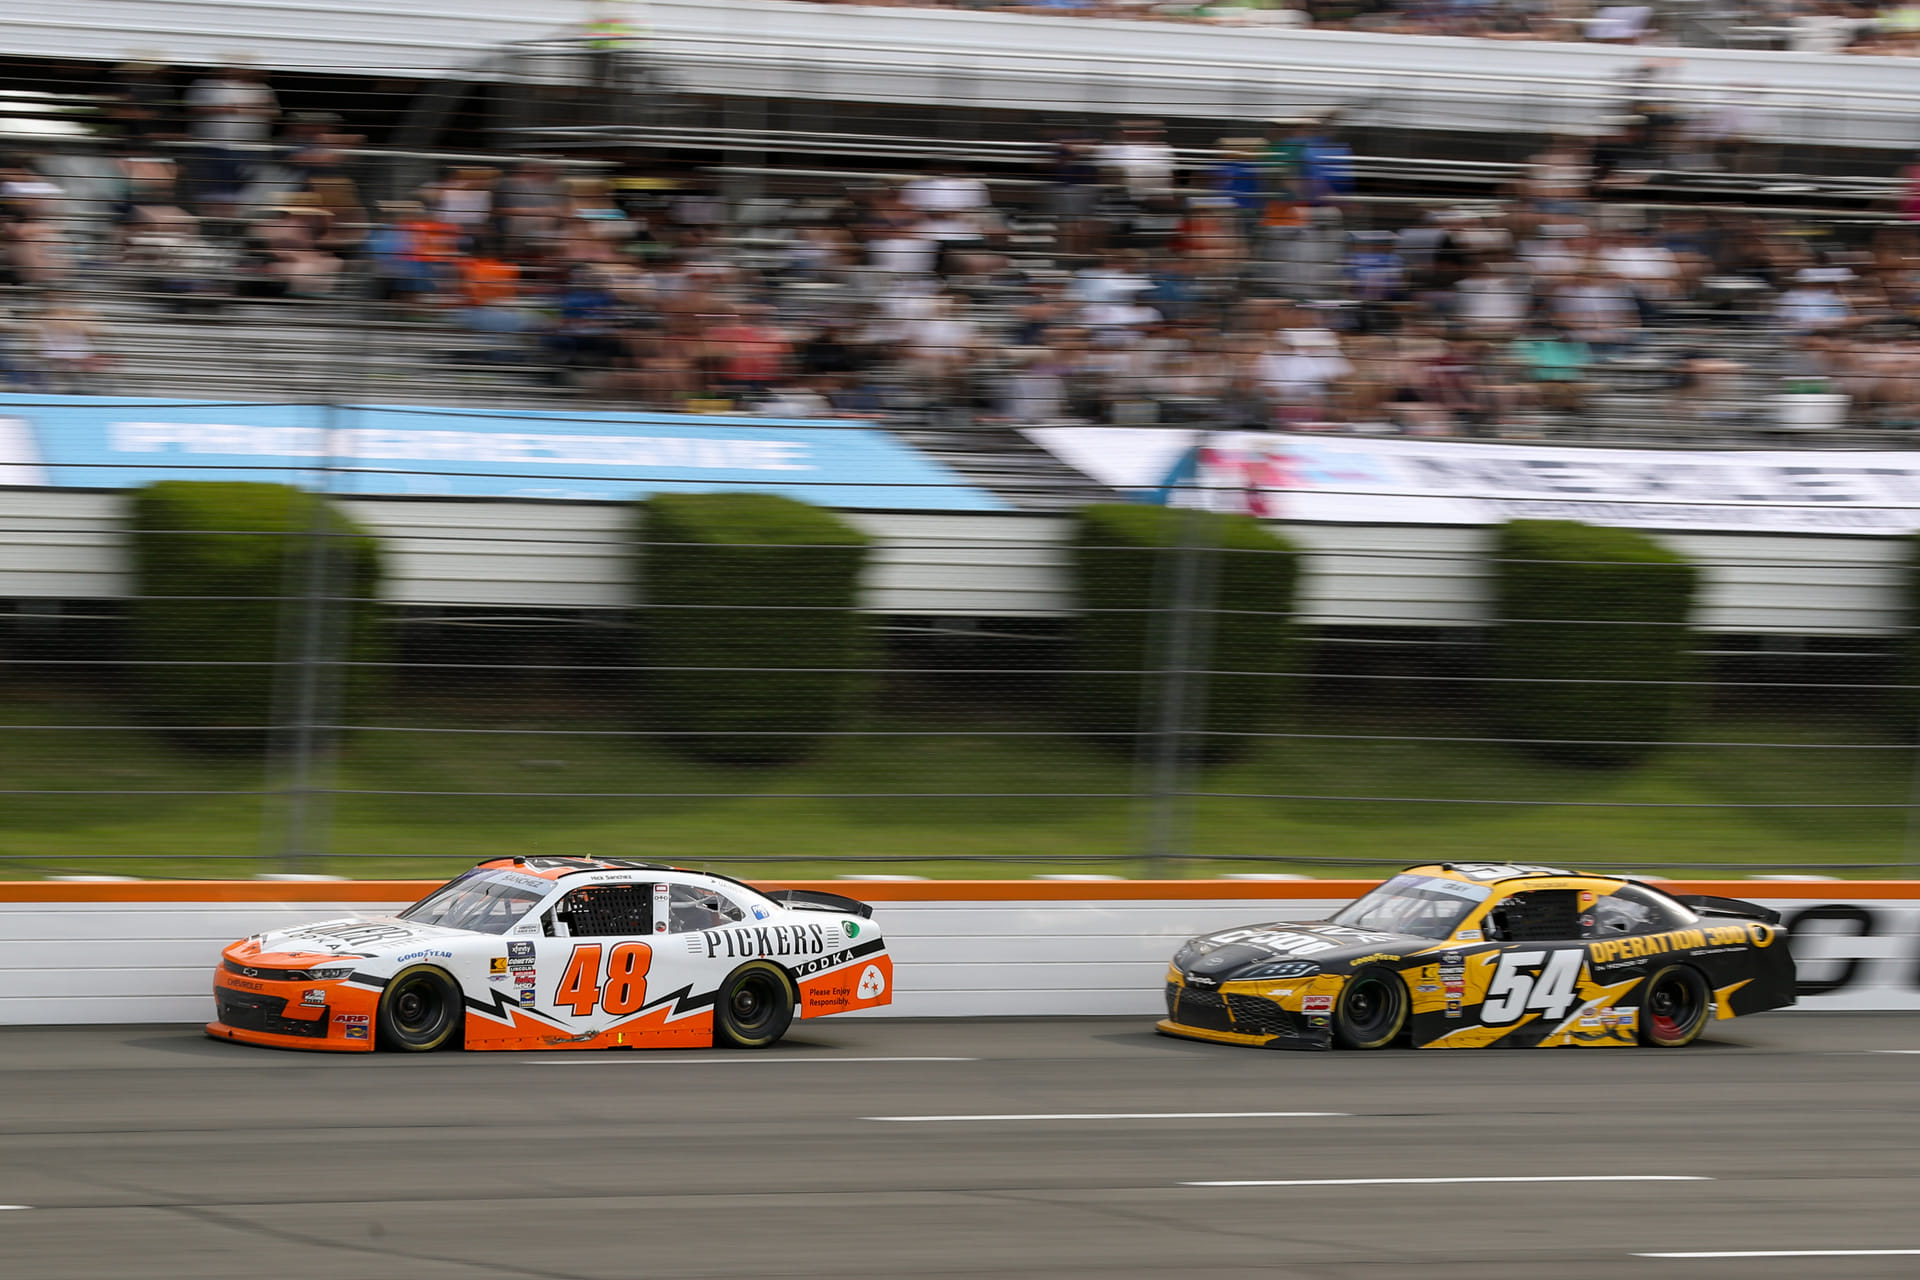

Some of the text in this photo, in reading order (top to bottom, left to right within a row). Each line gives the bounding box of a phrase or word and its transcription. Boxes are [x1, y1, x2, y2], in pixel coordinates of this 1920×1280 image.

[502, 874, 544, 889] SANCHEZ
[703, 924, 824, 958] PICKERS
[1589, 925, 1747, 964] OPERATION 300
[796, 950, 854, 976] VODKA
[227, 978, 263, 990] CHEVROLET
[553, 941, 652, 1016] 48
[1480, 949, 1584, 1023] 54
[810, 987, 850, 997] Please Enjoy
[810, 998, 850, 1007] Responsibly.
[335, 1015, 369, 1023] ARP
